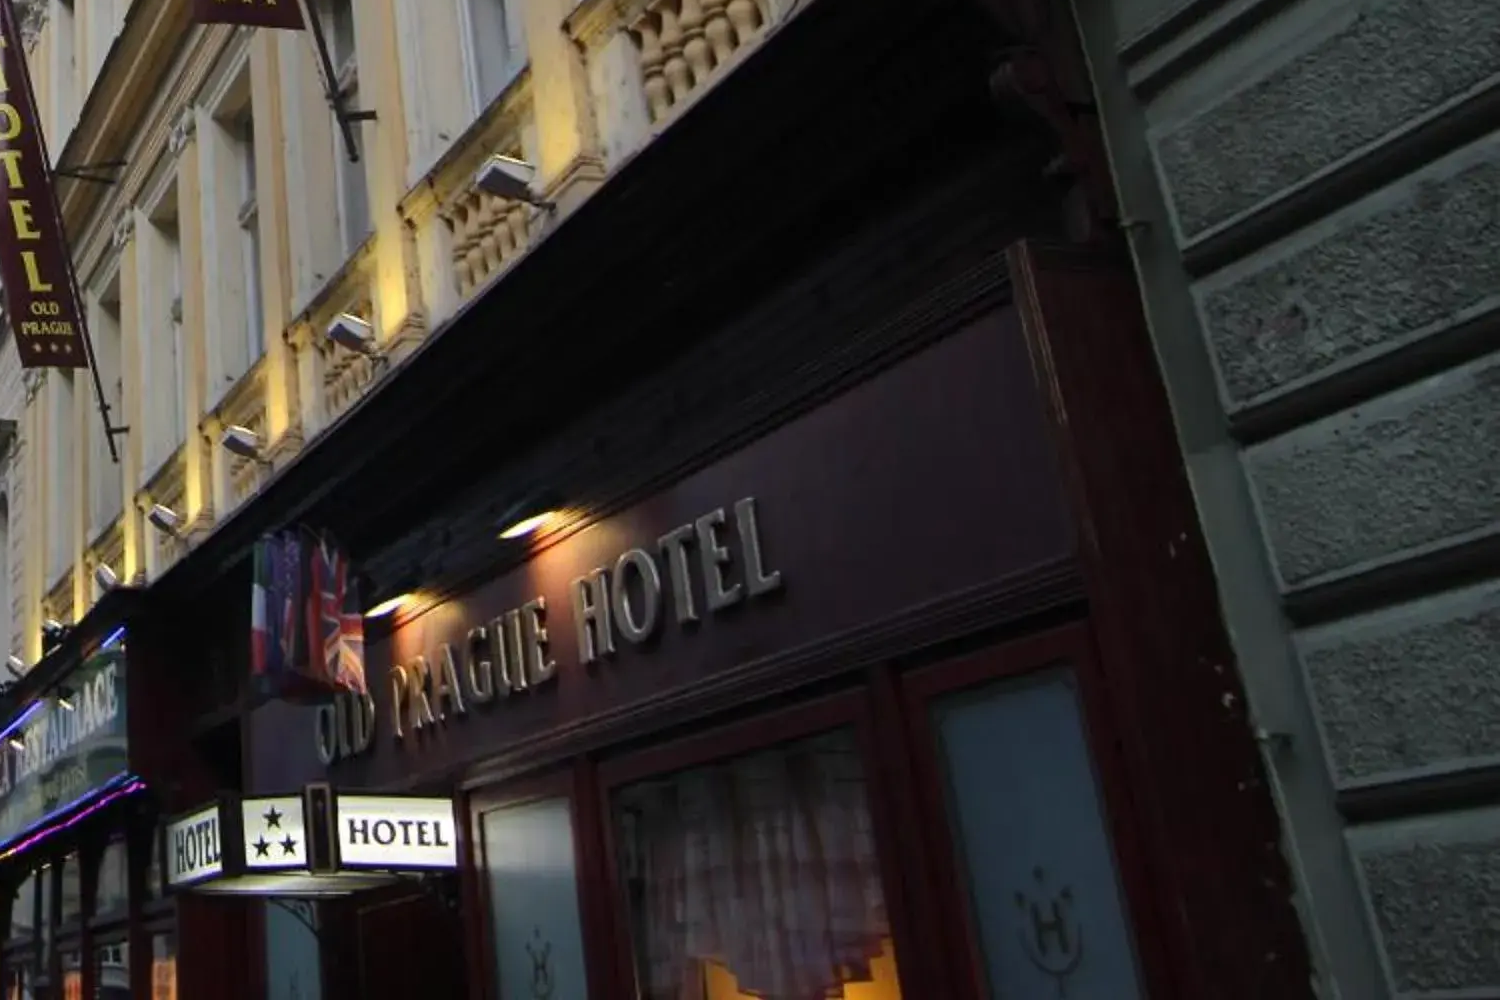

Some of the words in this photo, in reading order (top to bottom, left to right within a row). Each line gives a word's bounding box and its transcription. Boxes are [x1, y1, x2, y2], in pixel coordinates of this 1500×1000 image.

[30, 300, 60, 316] OLD
[20, 321, 74, 336] PRAGUE
[314, 691, 376, 766] OLD
[390, 596, 558, 738] PRAGUE
[571, 496, 781, 665] HOTEL
[174, 817, 223, 875] HOTEL
[348, 818, 450, 848] HOTEL
